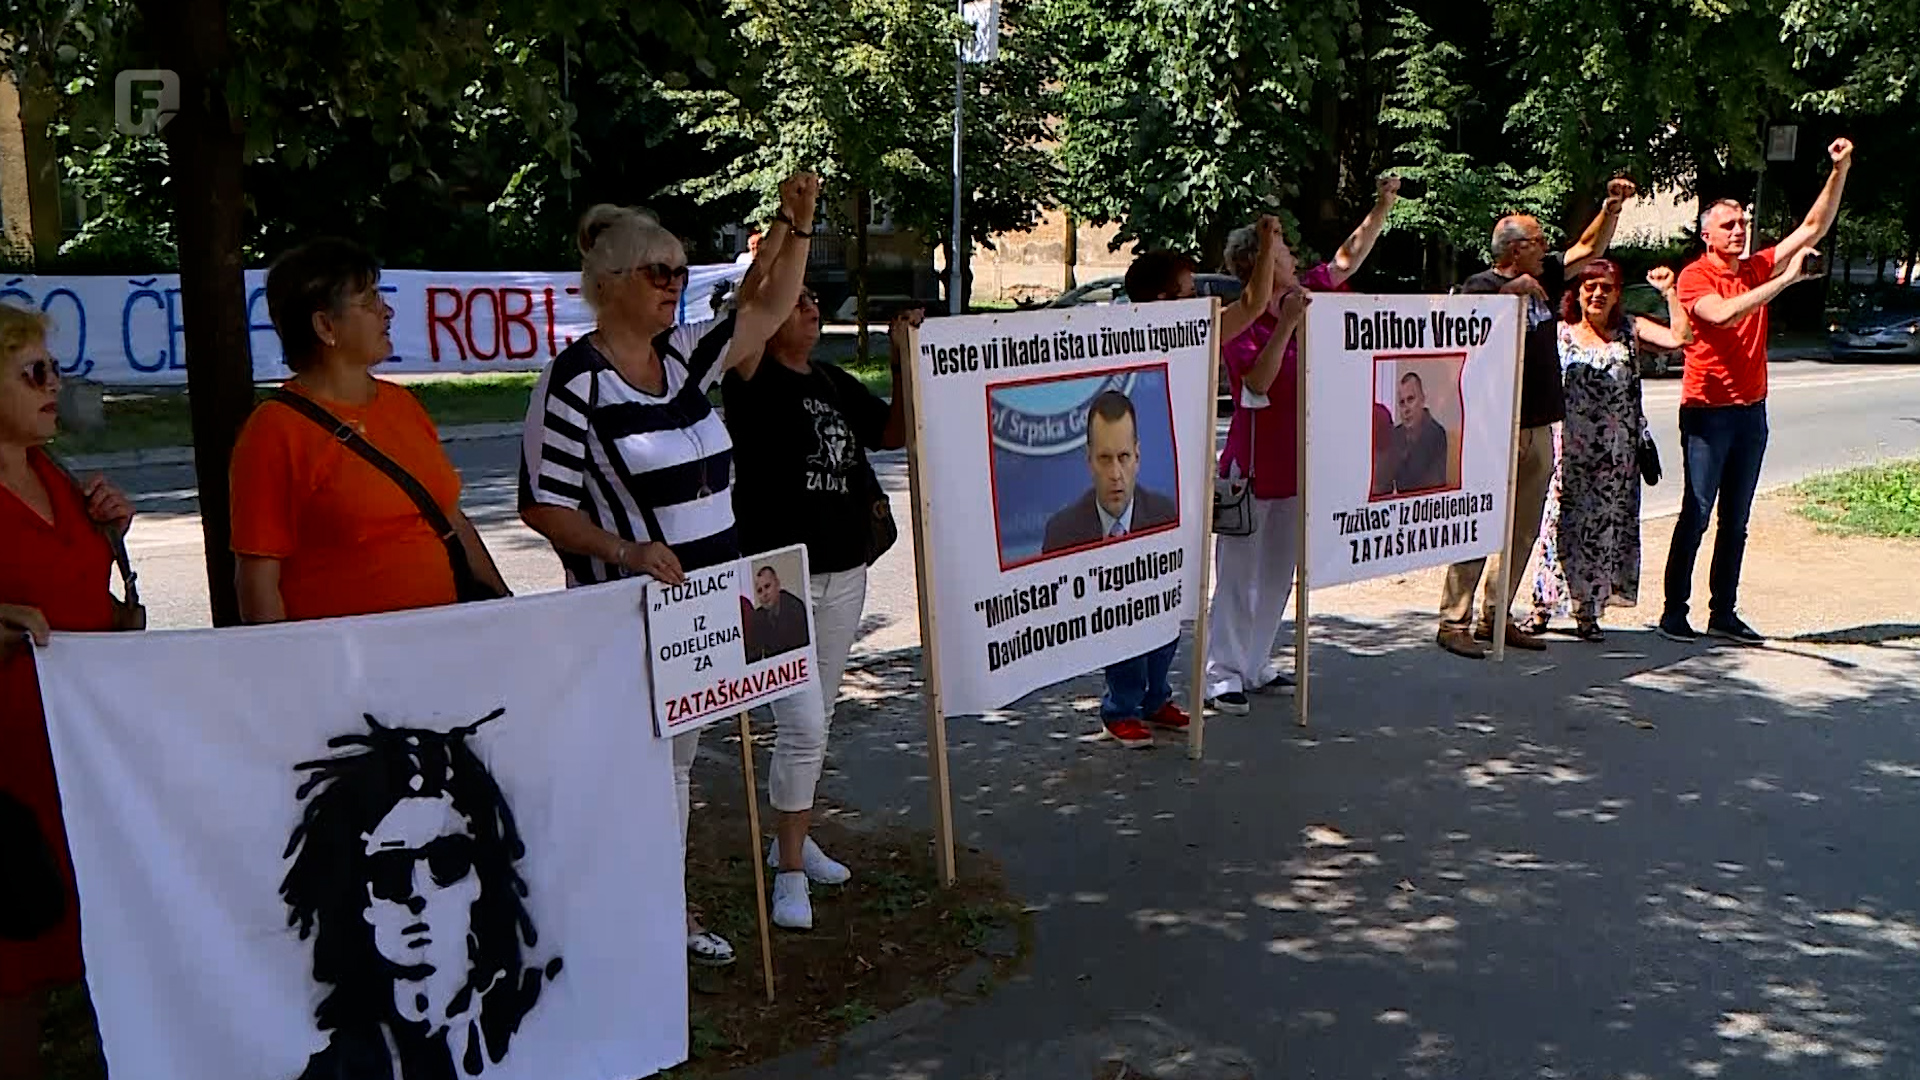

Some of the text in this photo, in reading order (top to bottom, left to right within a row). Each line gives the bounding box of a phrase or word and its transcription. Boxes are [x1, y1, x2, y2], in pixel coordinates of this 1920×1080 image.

[1344, 308, 1492, 351] Dalibor Vrećo
[982, 337, 998, 369] vi
[1001, 334, 1050, 367] ikada
[1053, 330, 1085, 361] išta
[1087, 333, 1099, 358] u
[1099, 327, 1145, 356] životu
[1008, 411, 1066, 447] Srpska
[1400, 502, 1410, 525] iz
[1412, 492, 1478, 524] Odjeljenja
[1480, 492, 1493, 512] za
[1350, 519, 1478, 564] ZATAŠKAVANJE
[1073, 576, 1085, 599] o
[694, 615, 706, 632] IZ
[987, 614, 1087, 672] Davidovom
[1091, 597, 1160, 635] donjem
[660, 626, 741, 661] ODJELJENJA
[694, 655, 713, 672] ZA
[665, 658, 808, 722] ZATAŠKAVANJE
